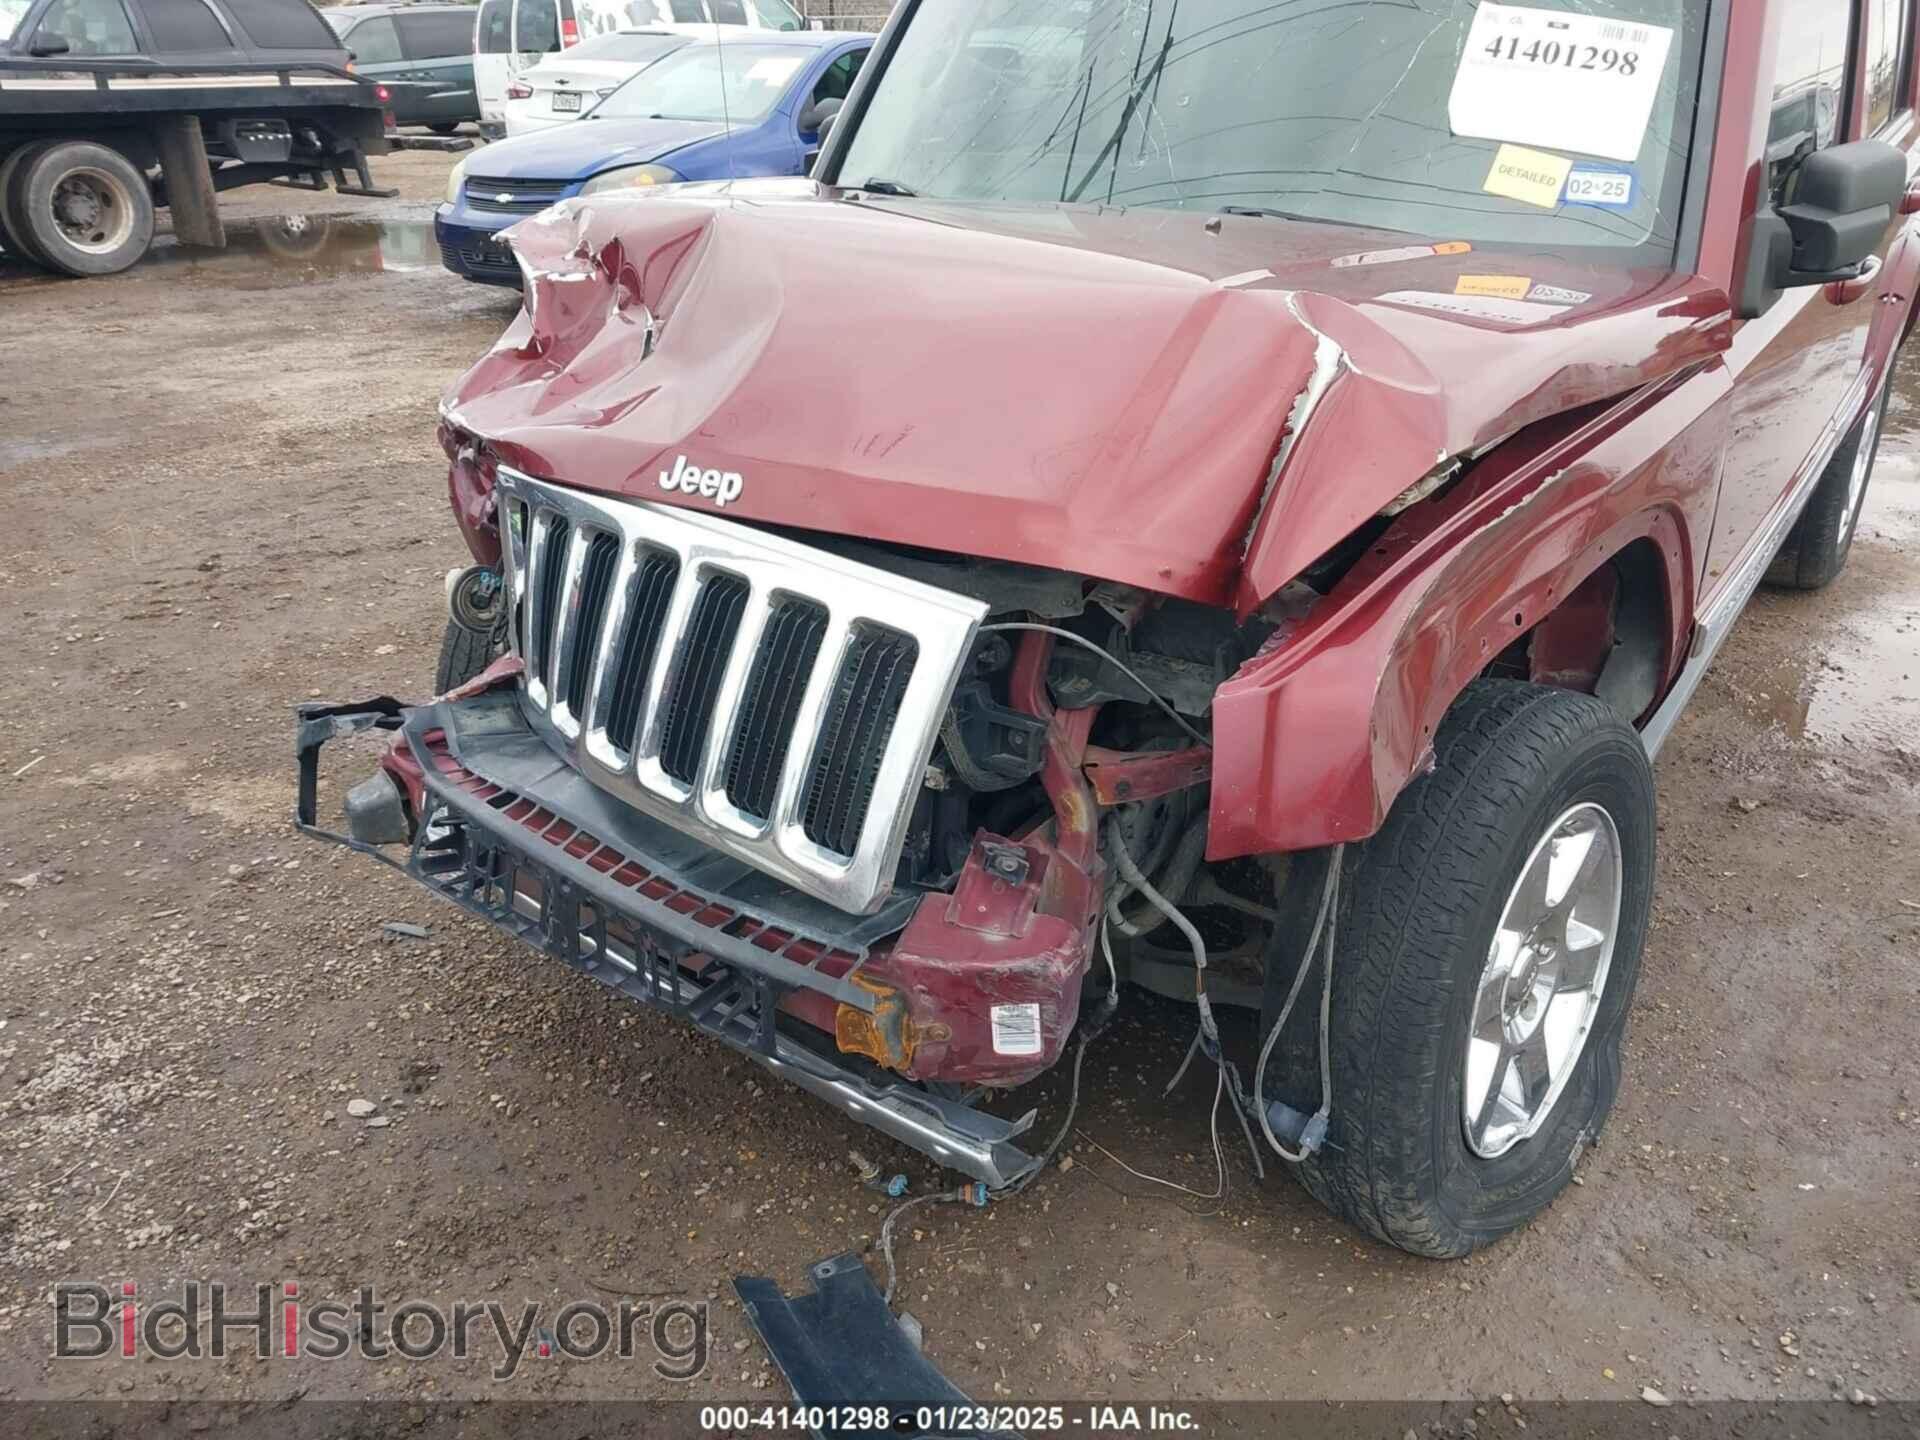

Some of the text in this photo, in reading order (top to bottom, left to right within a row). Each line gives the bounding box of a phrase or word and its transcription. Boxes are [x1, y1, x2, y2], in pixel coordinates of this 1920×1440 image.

[1485, 35, 1639, 76] 41401298
[1498, 163, 1557, 187] DETAILED
[659, 454, 743, 507] Jeep
